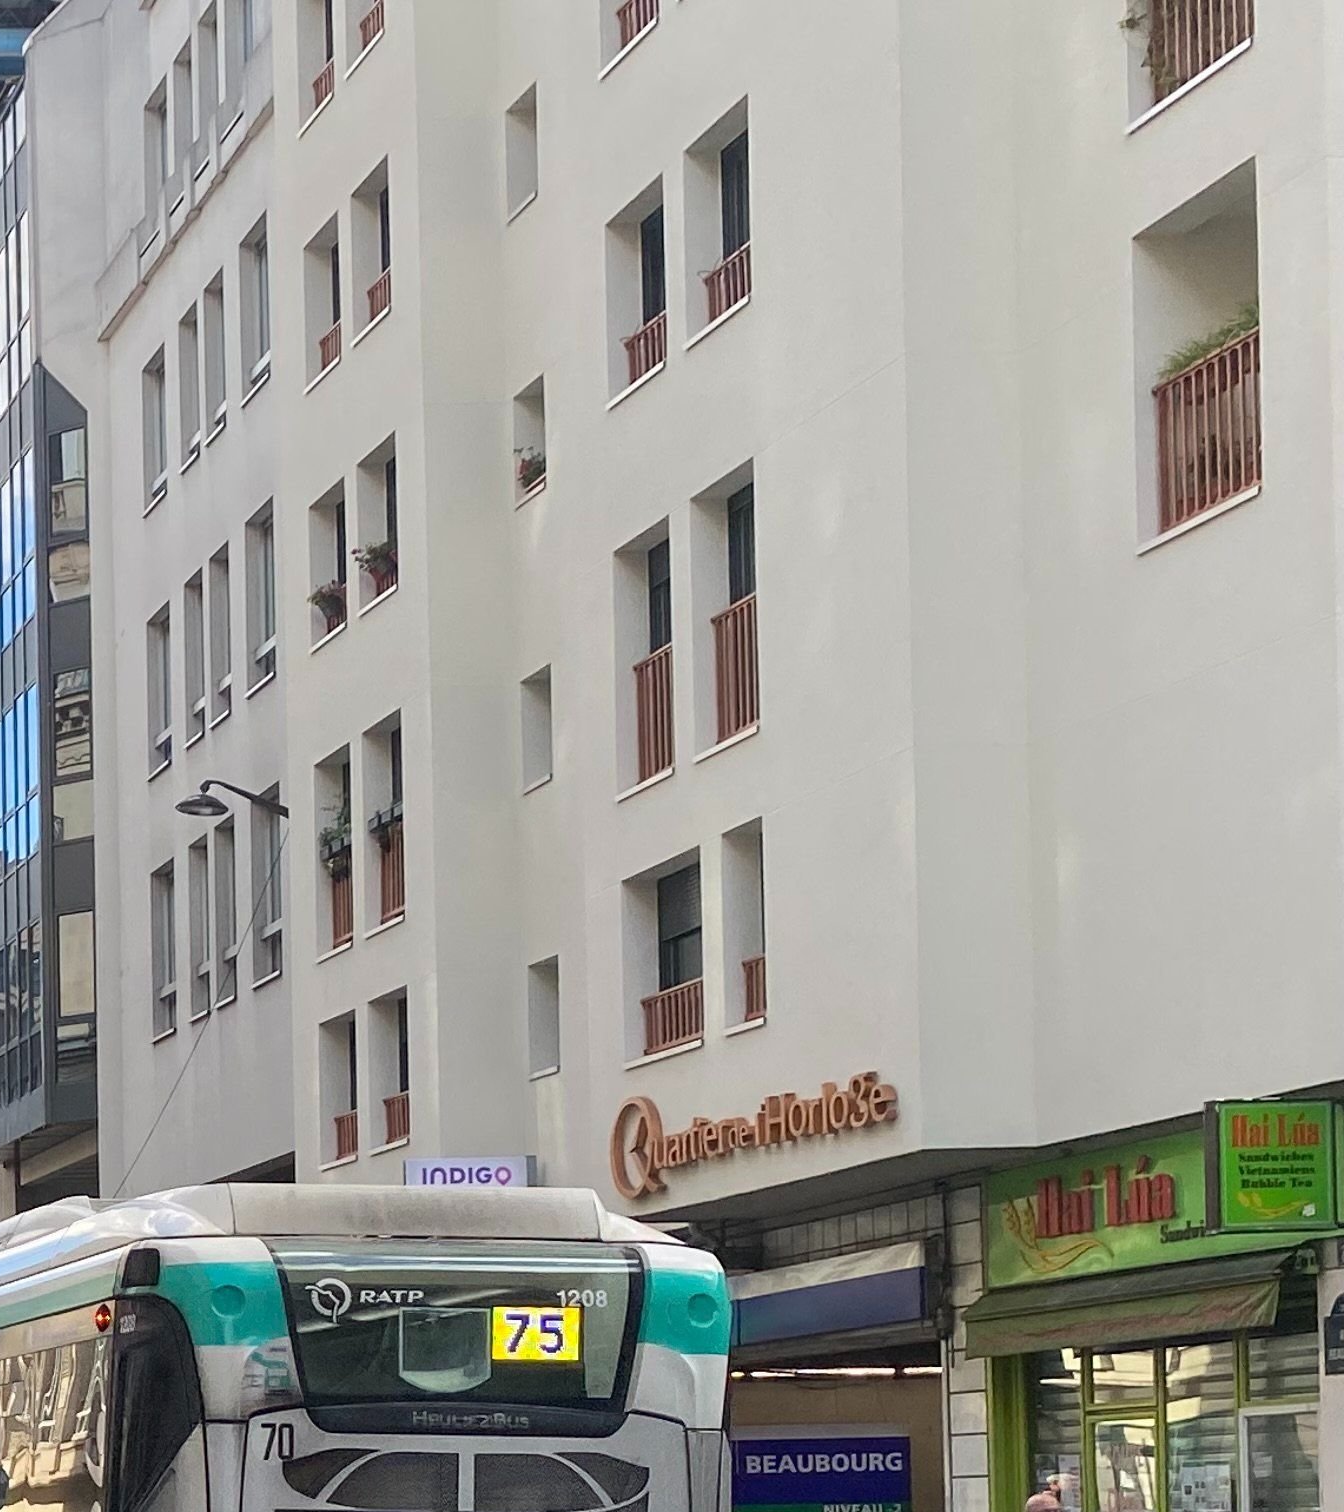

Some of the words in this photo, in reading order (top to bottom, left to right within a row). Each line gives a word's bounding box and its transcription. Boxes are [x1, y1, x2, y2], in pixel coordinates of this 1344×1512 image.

[610, 1096, 730, 1200] Quartier
[728, 1124, 756, 1148] de
[1238, 1152, 1316, 1163] Sandwiches
[1238, 1164, 1317, 1177] Vietnamiens
[1241, 1178, 1287, 1189] Bubble
[1290, 1178, 1313, 1189] Tea
[359, 1290, 426, 1305] RATP
[556, 1289, 609, 1308] 1208
[505, 1313, 565, 1354] 75
[261, 1422, 295, 1461] 70
[745, 1452, 904, 1475] BEAUBOURG
